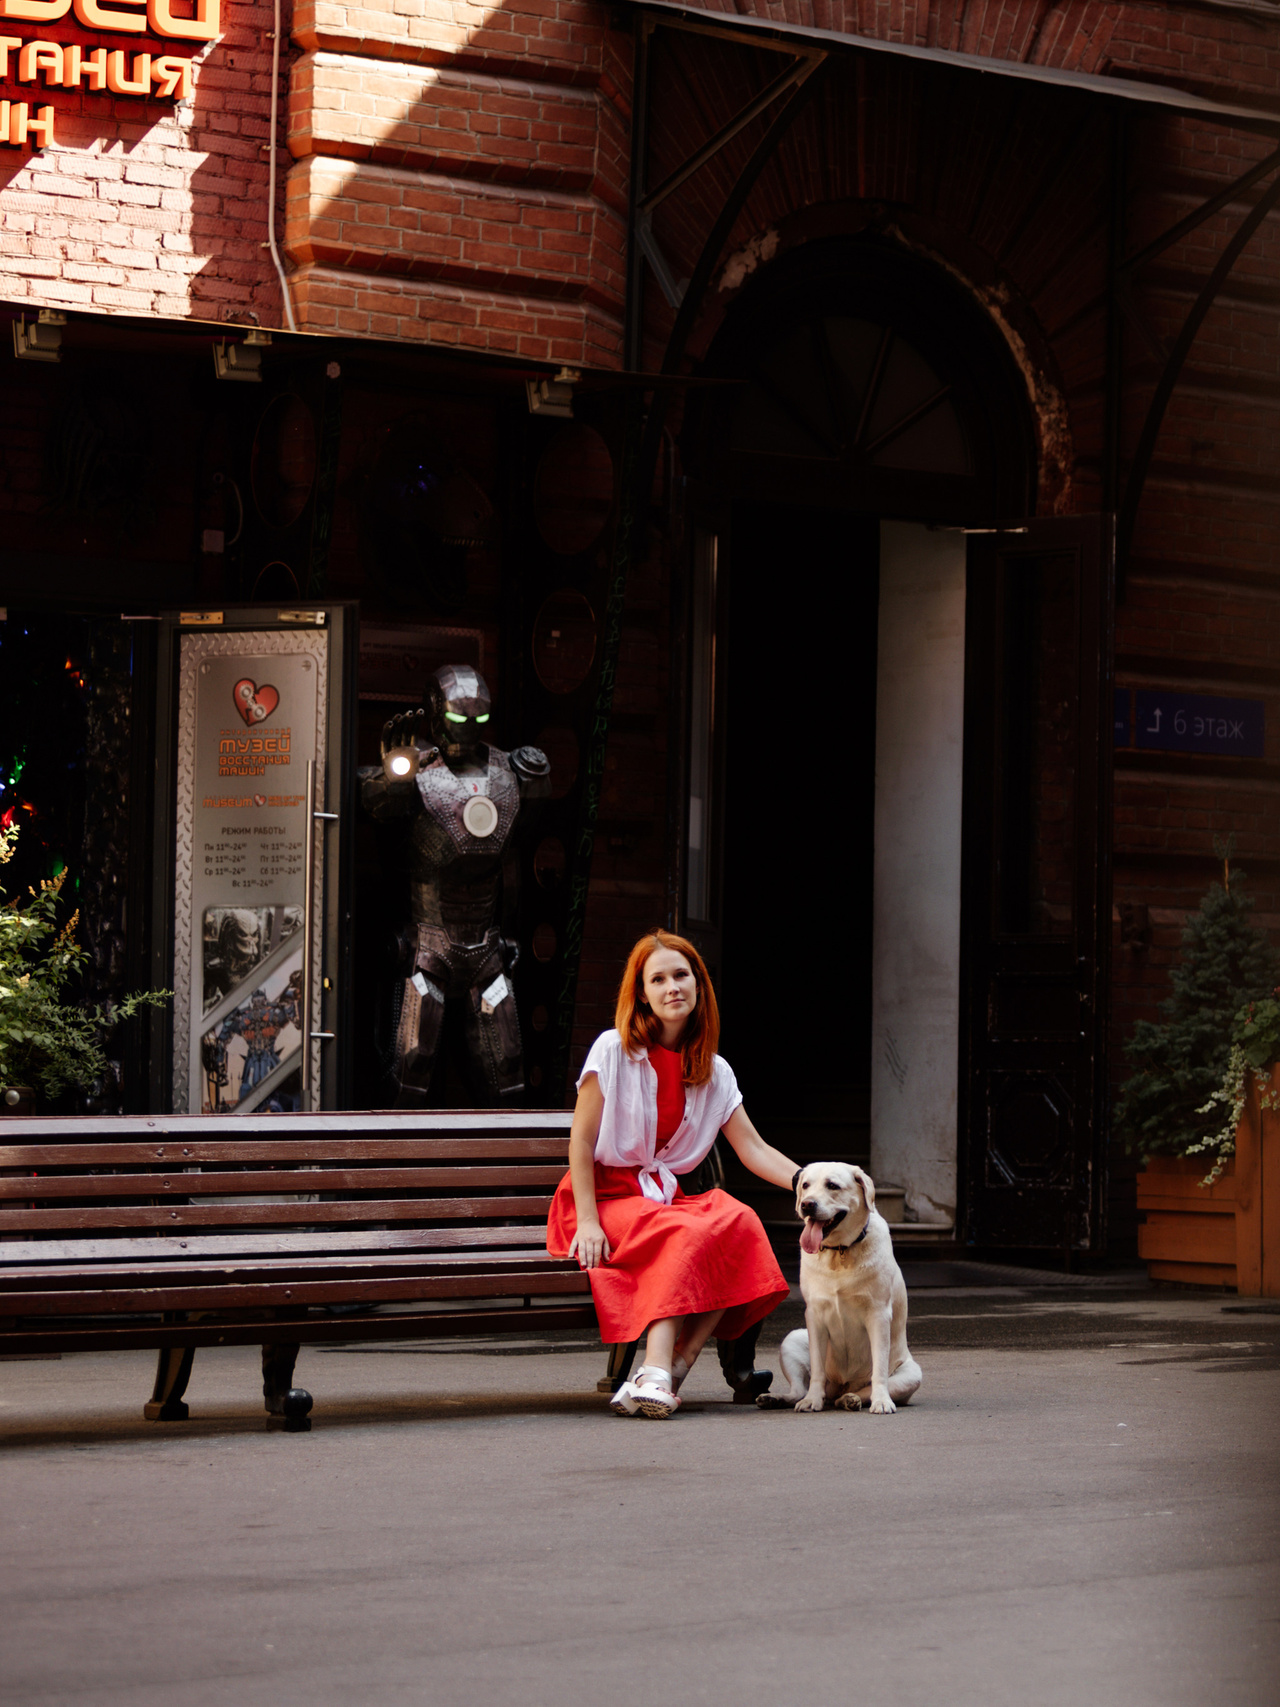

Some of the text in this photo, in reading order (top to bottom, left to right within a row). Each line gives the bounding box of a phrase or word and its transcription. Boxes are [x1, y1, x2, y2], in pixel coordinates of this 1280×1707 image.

[1174, 709, 1245, 740] 6 этаж
[219, 734, 291, 754] МУЗЕЙ
[219, 755, 291, 766] ВОССТАНИЯ
[219, 766, 266, 777] МАШИН
[221, 827, 287, 835] РЕЖИМ РАБОТЫ
